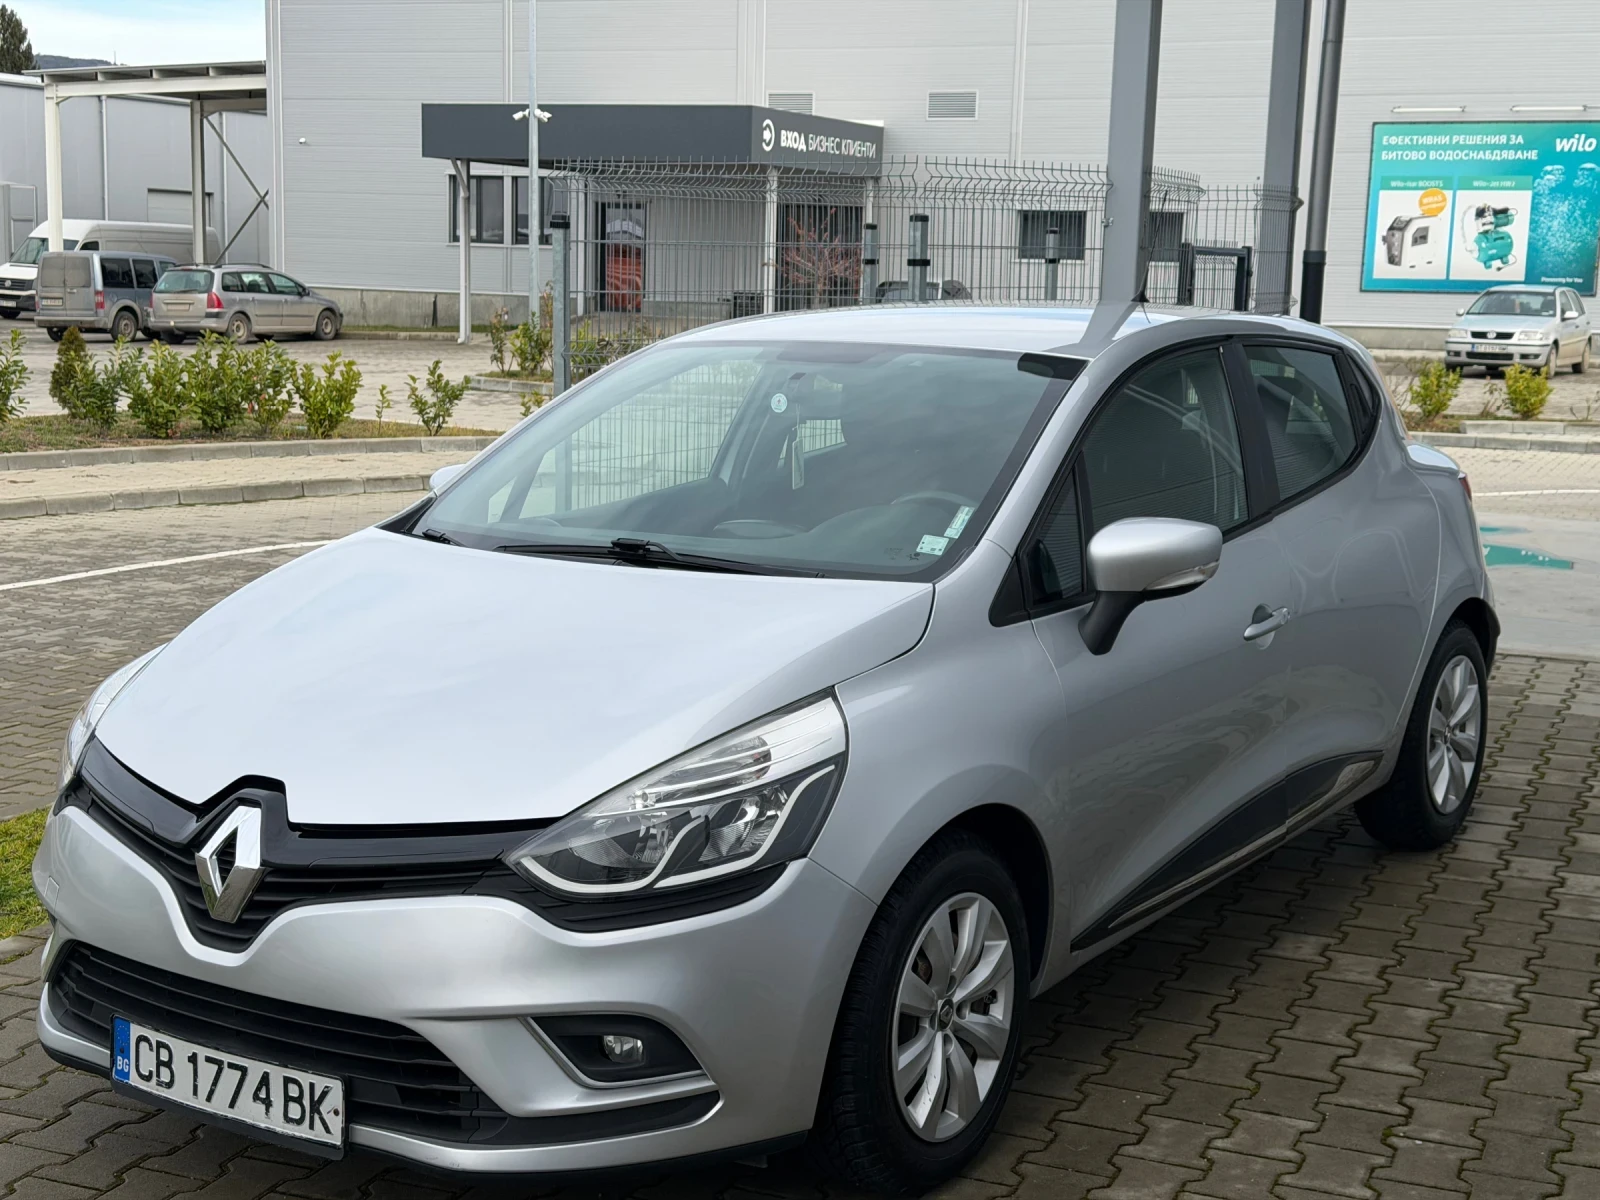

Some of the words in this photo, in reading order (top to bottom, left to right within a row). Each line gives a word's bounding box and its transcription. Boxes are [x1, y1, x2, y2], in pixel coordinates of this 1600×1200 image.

[780, 129, 807, 152] ВХОД
[808, 134, 840, 154] БИЗНЕС
[841, 138, 876, 158] КЛИЕНТИ
[1382, 135, 1450, 145] ЕФЕКТИВНИ
[1452, 134, 1507, 145] РЕШЕНИЯ
[1509, 134, 1524, 145] ЗА
[1555, 134, 1597, 153] wilo
[1381, 150, 1427, 161] БИТОВО
[1429, 149, 1538, 161] ВОДОСНАБДЯВАНЕ
[116, 1055, 130, 1073] BG
[134, 1033, 175, 1090] CB
[187, 1051, 274, 1119] 1774
[282, 1074, 334, 1136] BK
